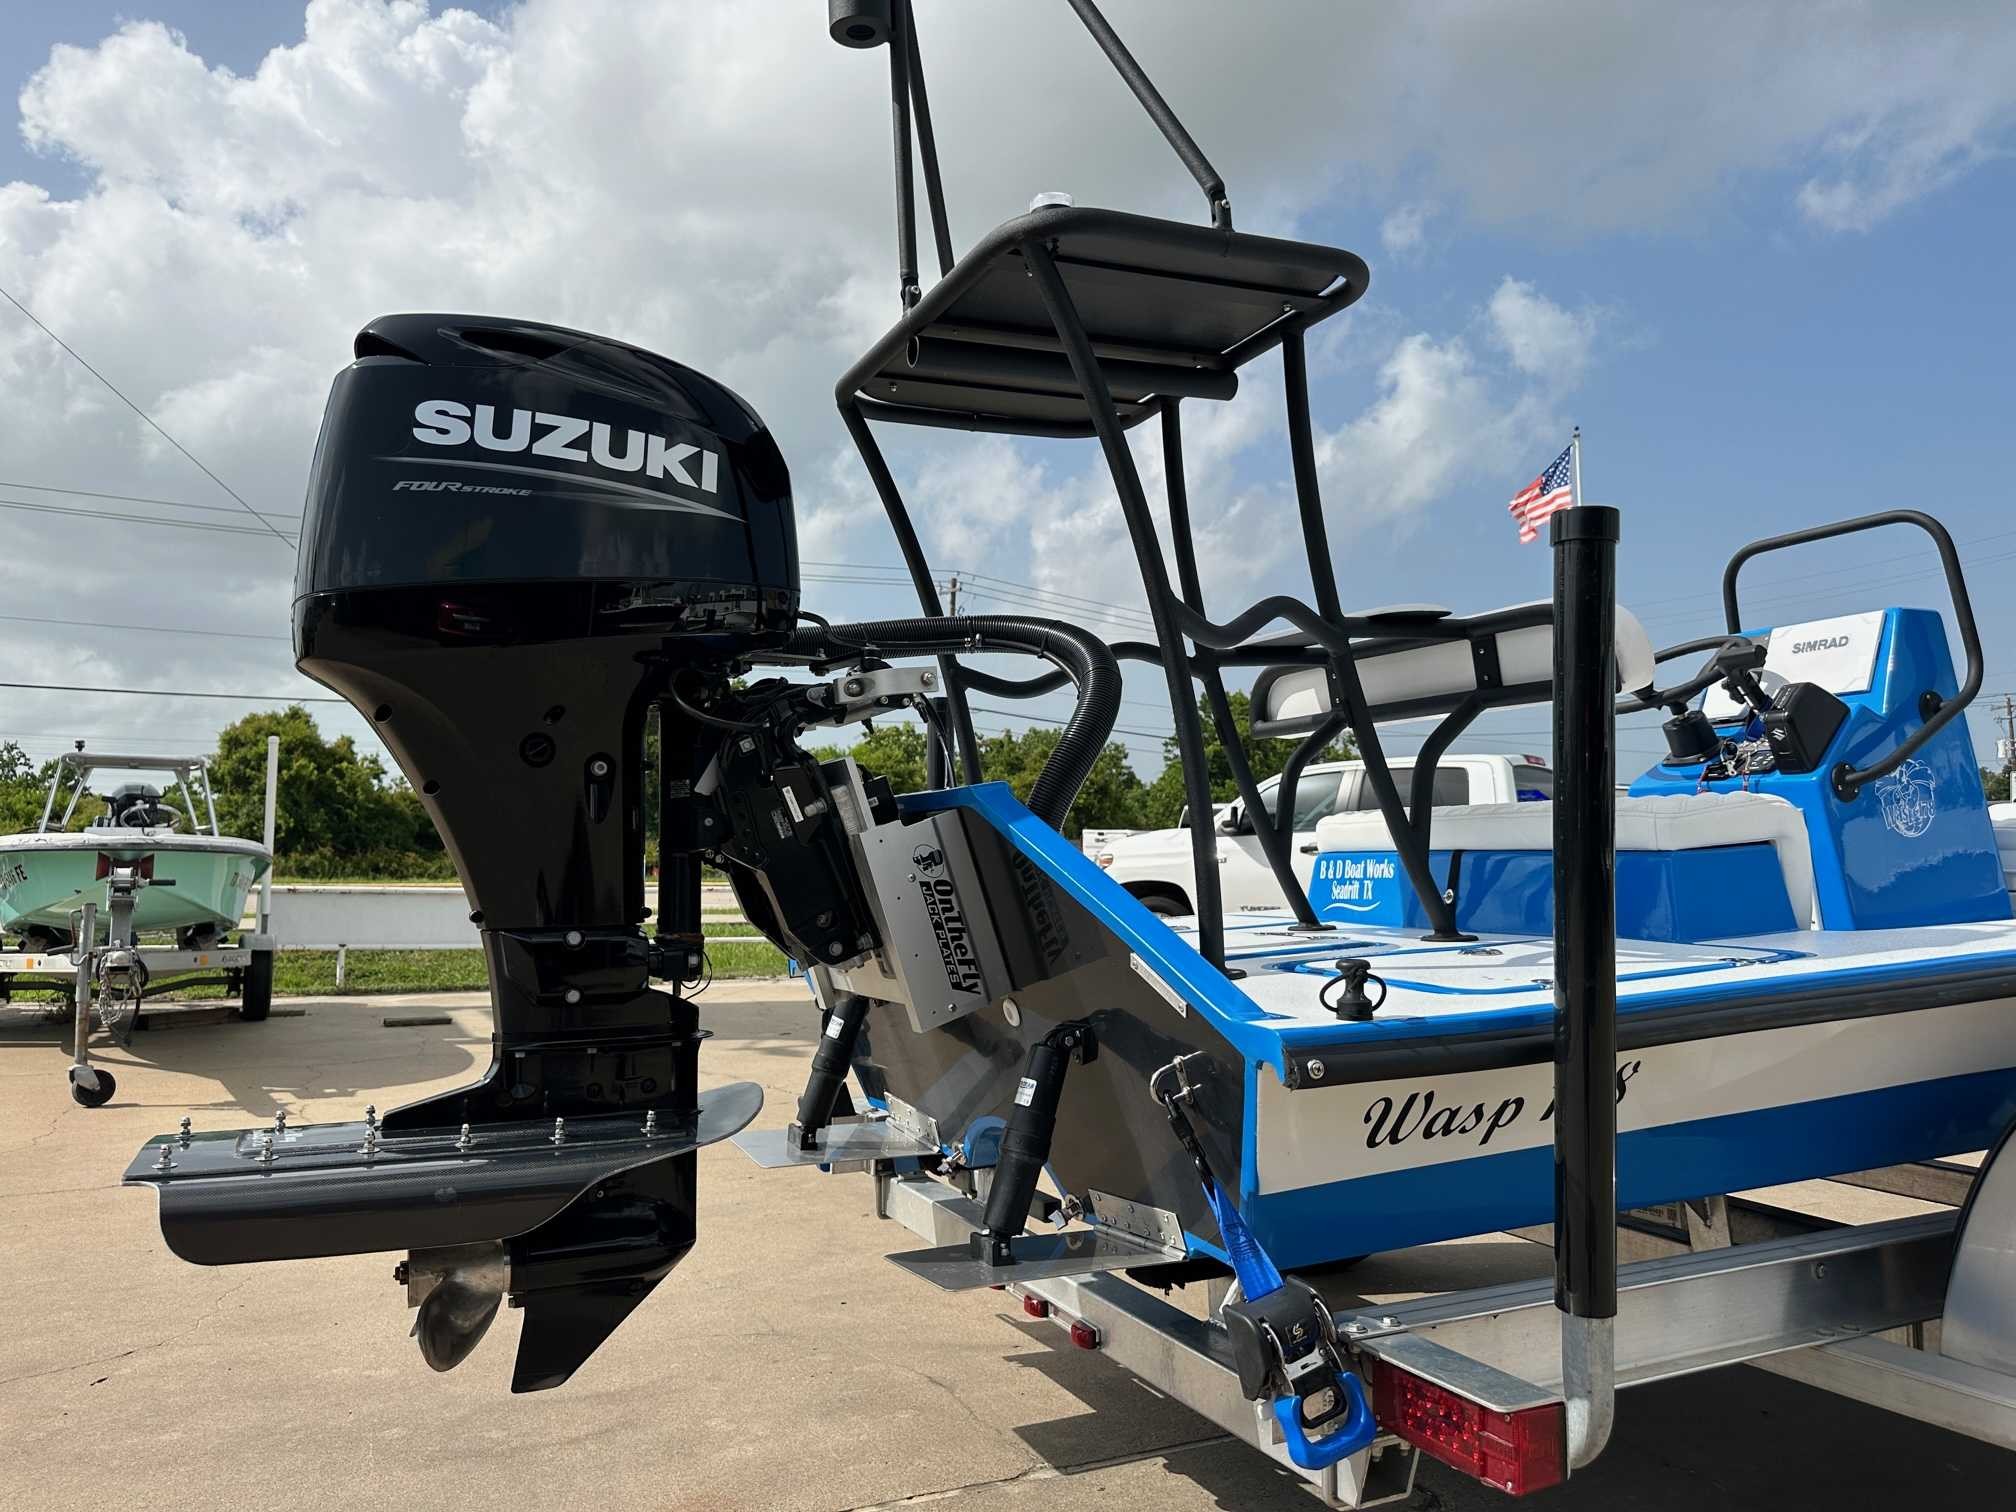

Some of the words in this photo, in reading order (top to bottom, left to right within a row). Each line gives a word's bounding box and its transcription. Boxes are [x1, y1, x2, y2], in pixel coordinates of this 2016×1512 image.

[412, 399, 719, 494] SUZUKI
[1791, 635, 1849, 654] SIMRAD
[1319, 860, 1327, 879] B
[1327, 859, 1335, 879] &
[1335, 859, 1343, 879] D
[1344, 859, 1365, 879] Boat
[1366, 858, 1395, 879] Works
[1331, 880, 1360, 900] Seadrift
[1363, 880, 1374, 900] TX
[921, 885, 941, 923] JACK
[935, 929, 960, 983] PLATES
[1363, 1090, 1525, 1149] Wasp
